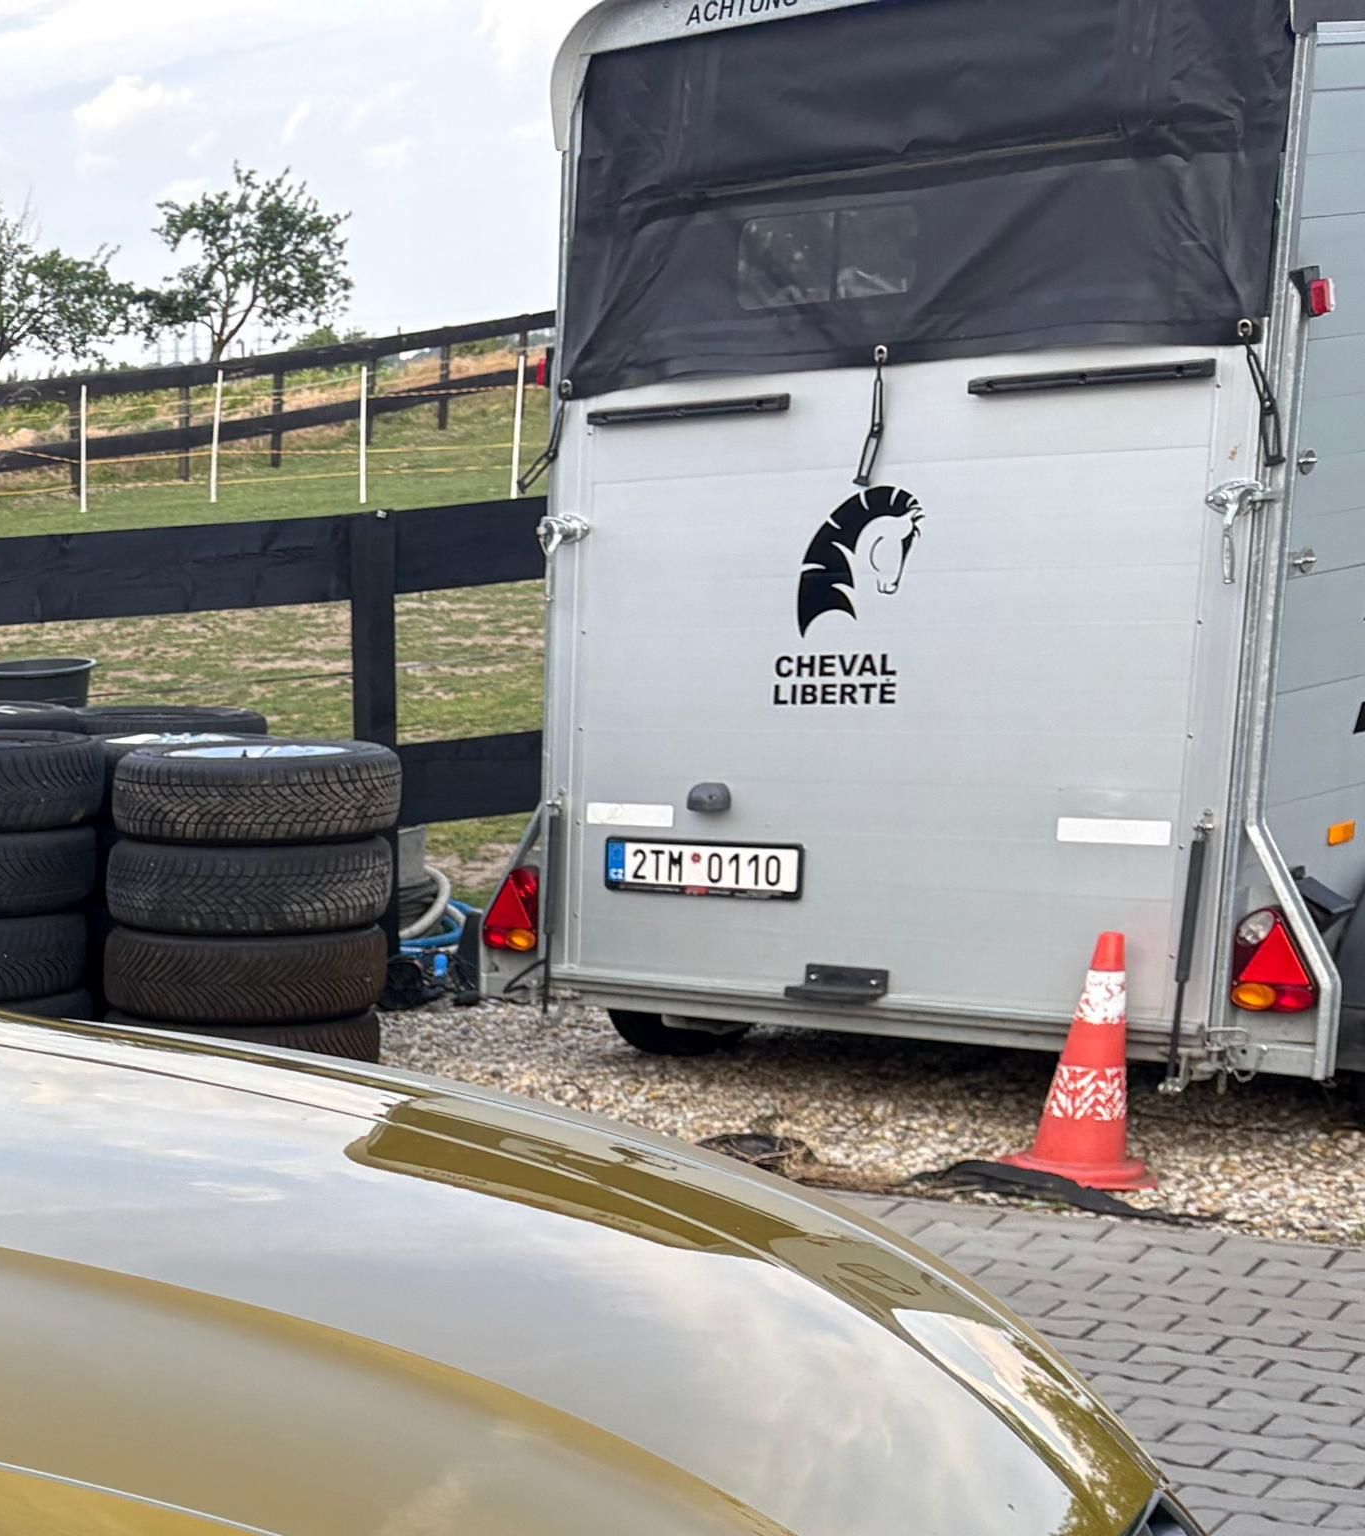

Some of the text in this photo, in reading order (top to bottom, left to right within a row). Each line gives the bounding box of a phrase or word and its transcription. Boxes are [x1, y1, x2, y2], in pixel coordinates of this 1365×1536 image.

[685, 0, 798, 26] ACHTU
[774, 653, 897, 678] CHEVAL
[632, 849, 781, 886] 2TM 0110
